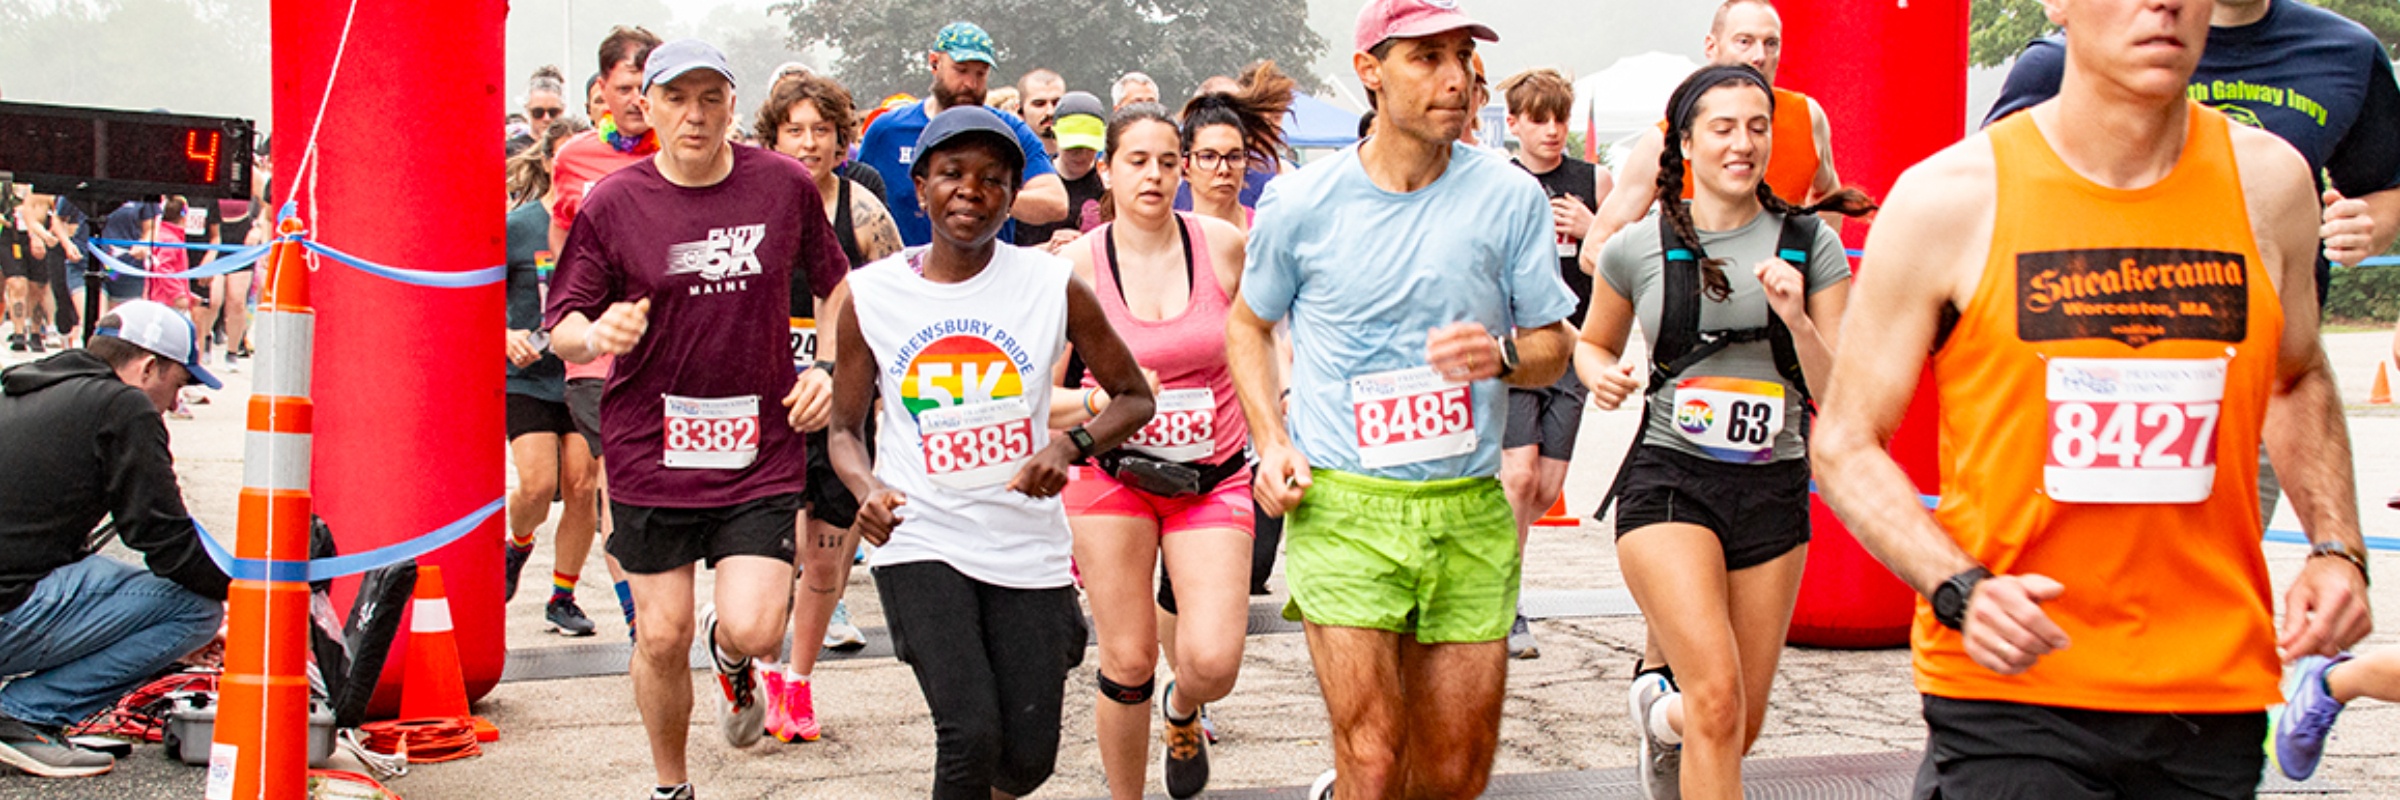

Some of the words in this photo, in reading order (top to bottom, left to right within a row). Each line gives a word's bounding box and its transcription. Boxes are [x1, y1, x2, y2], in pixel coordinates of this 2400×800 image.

[2211, 80, 2284, 107] Galway
[2287, 88, 2328, 127] Invy
[187, 129, 218, 182] 4
[703, 236, 764, 278] 5K
[689, 280, 748, 296] MAINE
[2025, 258, 2244, 313] Sneakerama
[2061, 301, 2176, 318] Worcester,
[2178, 301, 2213, 317] MA
[889, 318, 993, 378] SHREWSBURY
[993, 328, 1035, 377] PRIDE
[917, 361, 1008, 410] 5K
[668, 417, 756, 451] 8382
[1360, 388, 1469, 446] 8485
[1680, 404, 1712, 427] 5K
[1726, 400, 1772, 444] 63
[2052, 401, 2220, 468] 8427
[926, 421, 1029, 474] 8385
